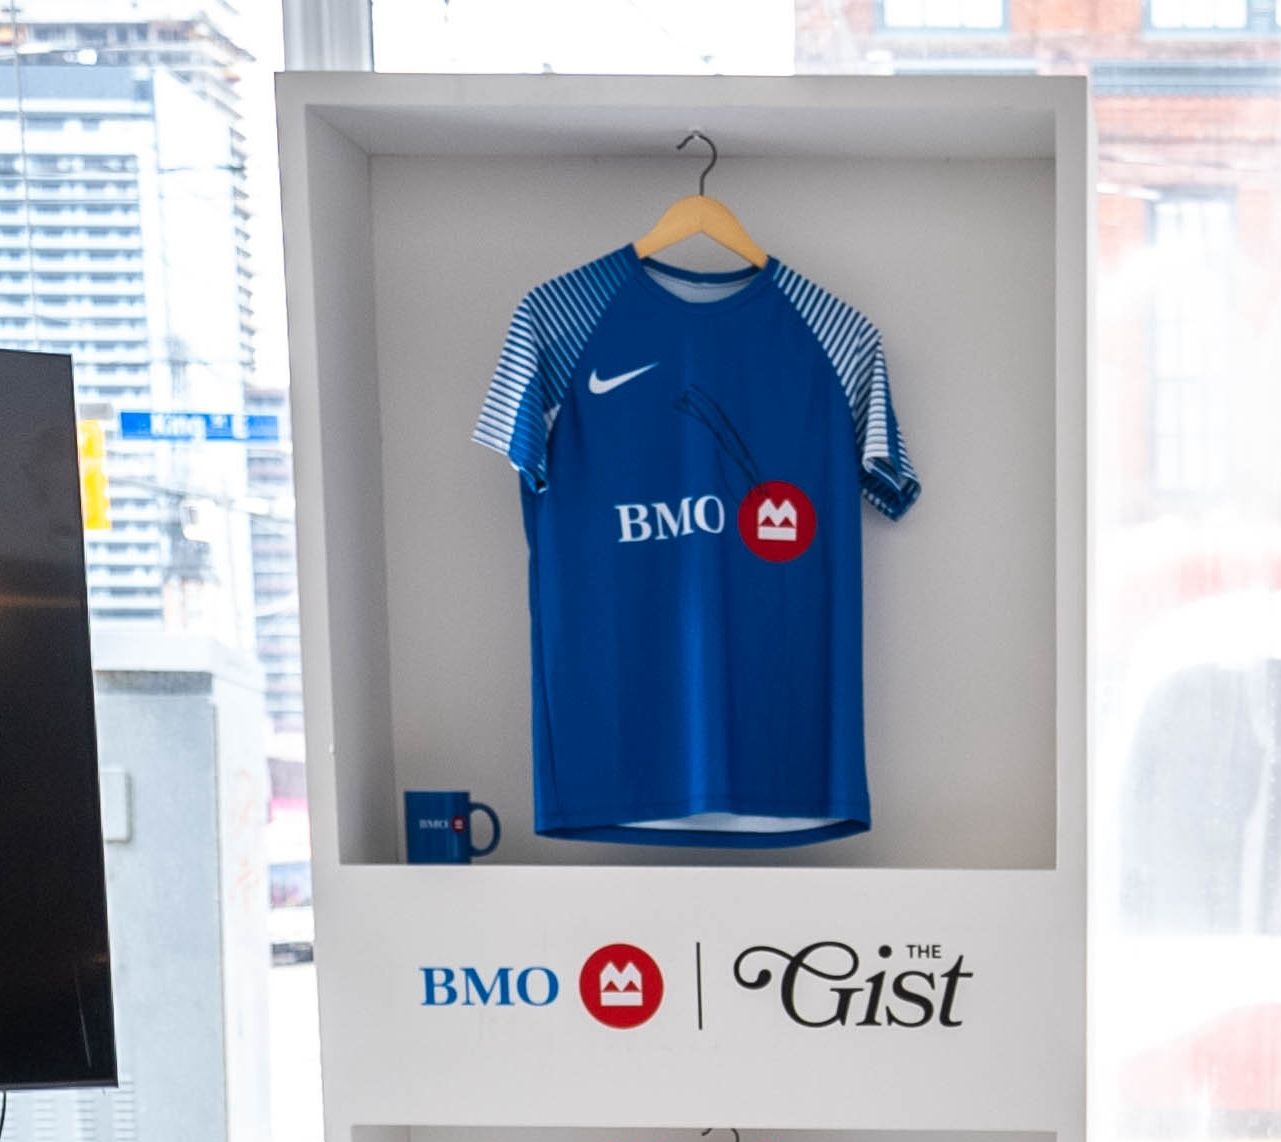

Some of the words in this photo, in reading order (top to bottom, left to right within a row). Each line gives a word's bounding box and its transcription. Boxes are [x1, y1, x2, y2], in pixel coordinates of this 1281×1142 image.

[615, 495, 725, 542] BMO
[905, 944, 942, 959] THE
[420, 967, 560, 1007] BMO
[733, 941, 974, 1028] Gist
